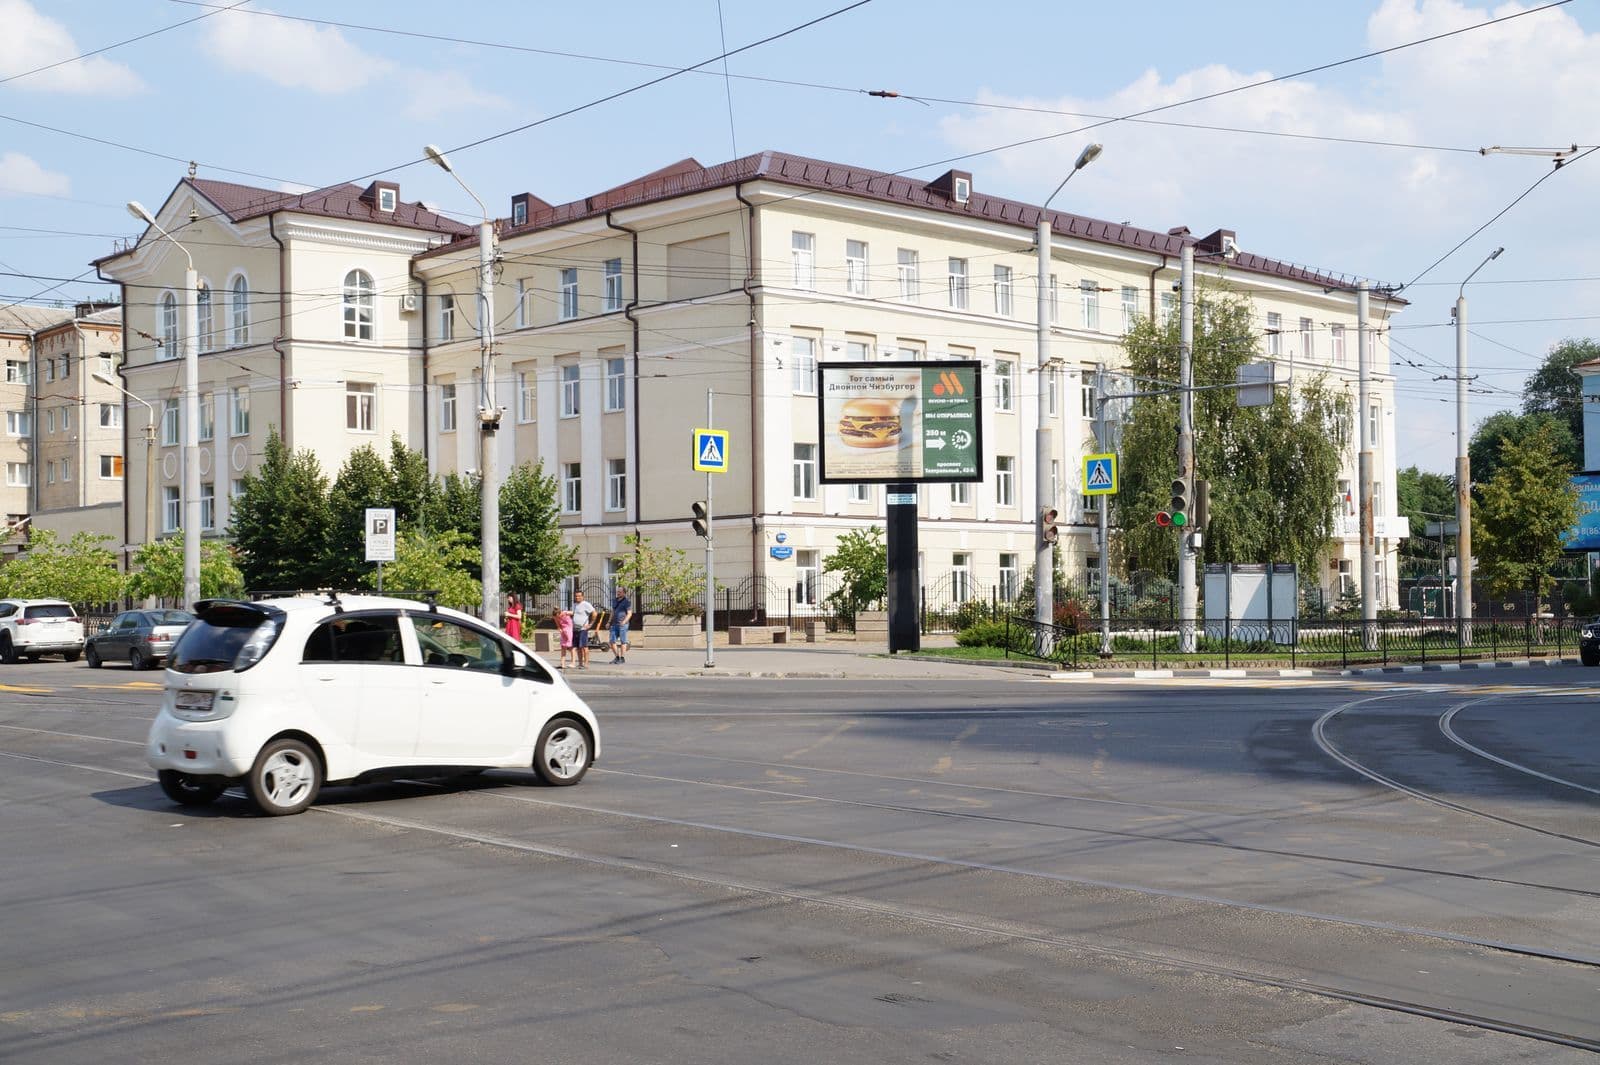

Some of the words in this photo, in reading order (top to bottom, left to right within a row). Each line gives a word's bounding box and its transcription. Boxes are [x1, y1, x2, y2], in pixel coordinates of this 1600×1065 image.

[865, 374, 894, 382] самый
[829, 383, 867, 391] Двойной
[869, 383, 915, 392] Чизбургер
